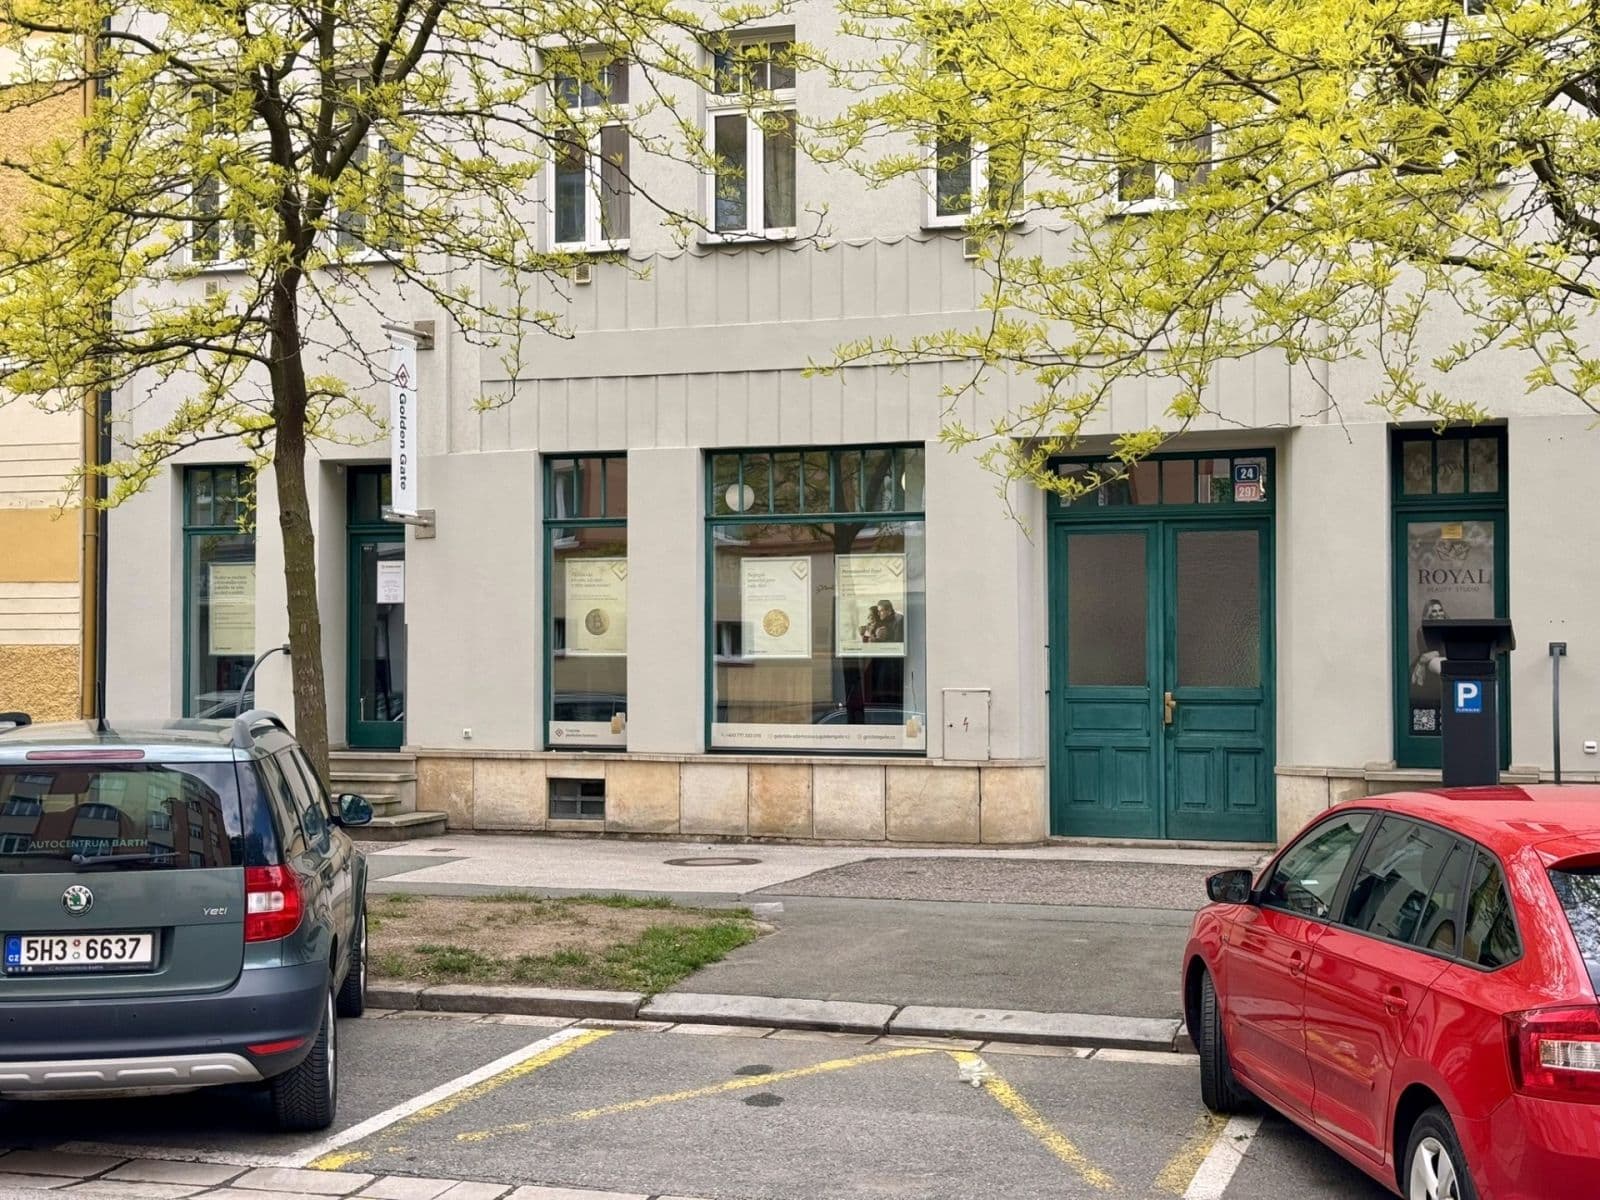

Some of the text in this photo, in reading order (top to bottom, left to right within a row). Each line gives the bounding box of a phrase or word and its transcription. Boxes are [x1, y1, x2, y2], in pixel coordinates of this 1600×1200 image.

[399, 393, 408, 490] Golden Gate
[1240, 468, 1254, 479] 24
[1239, 486, 1257, 497] 297
[1418, 569, 1490, 585] ROYAL
[1457, 682, 1478, 708] P
[29, 838, 148, 850] AUTOCENTRUM BARTH
[26, 937, 142, 961] 5H3 6637
[8, 954, 19, 962] CZ
